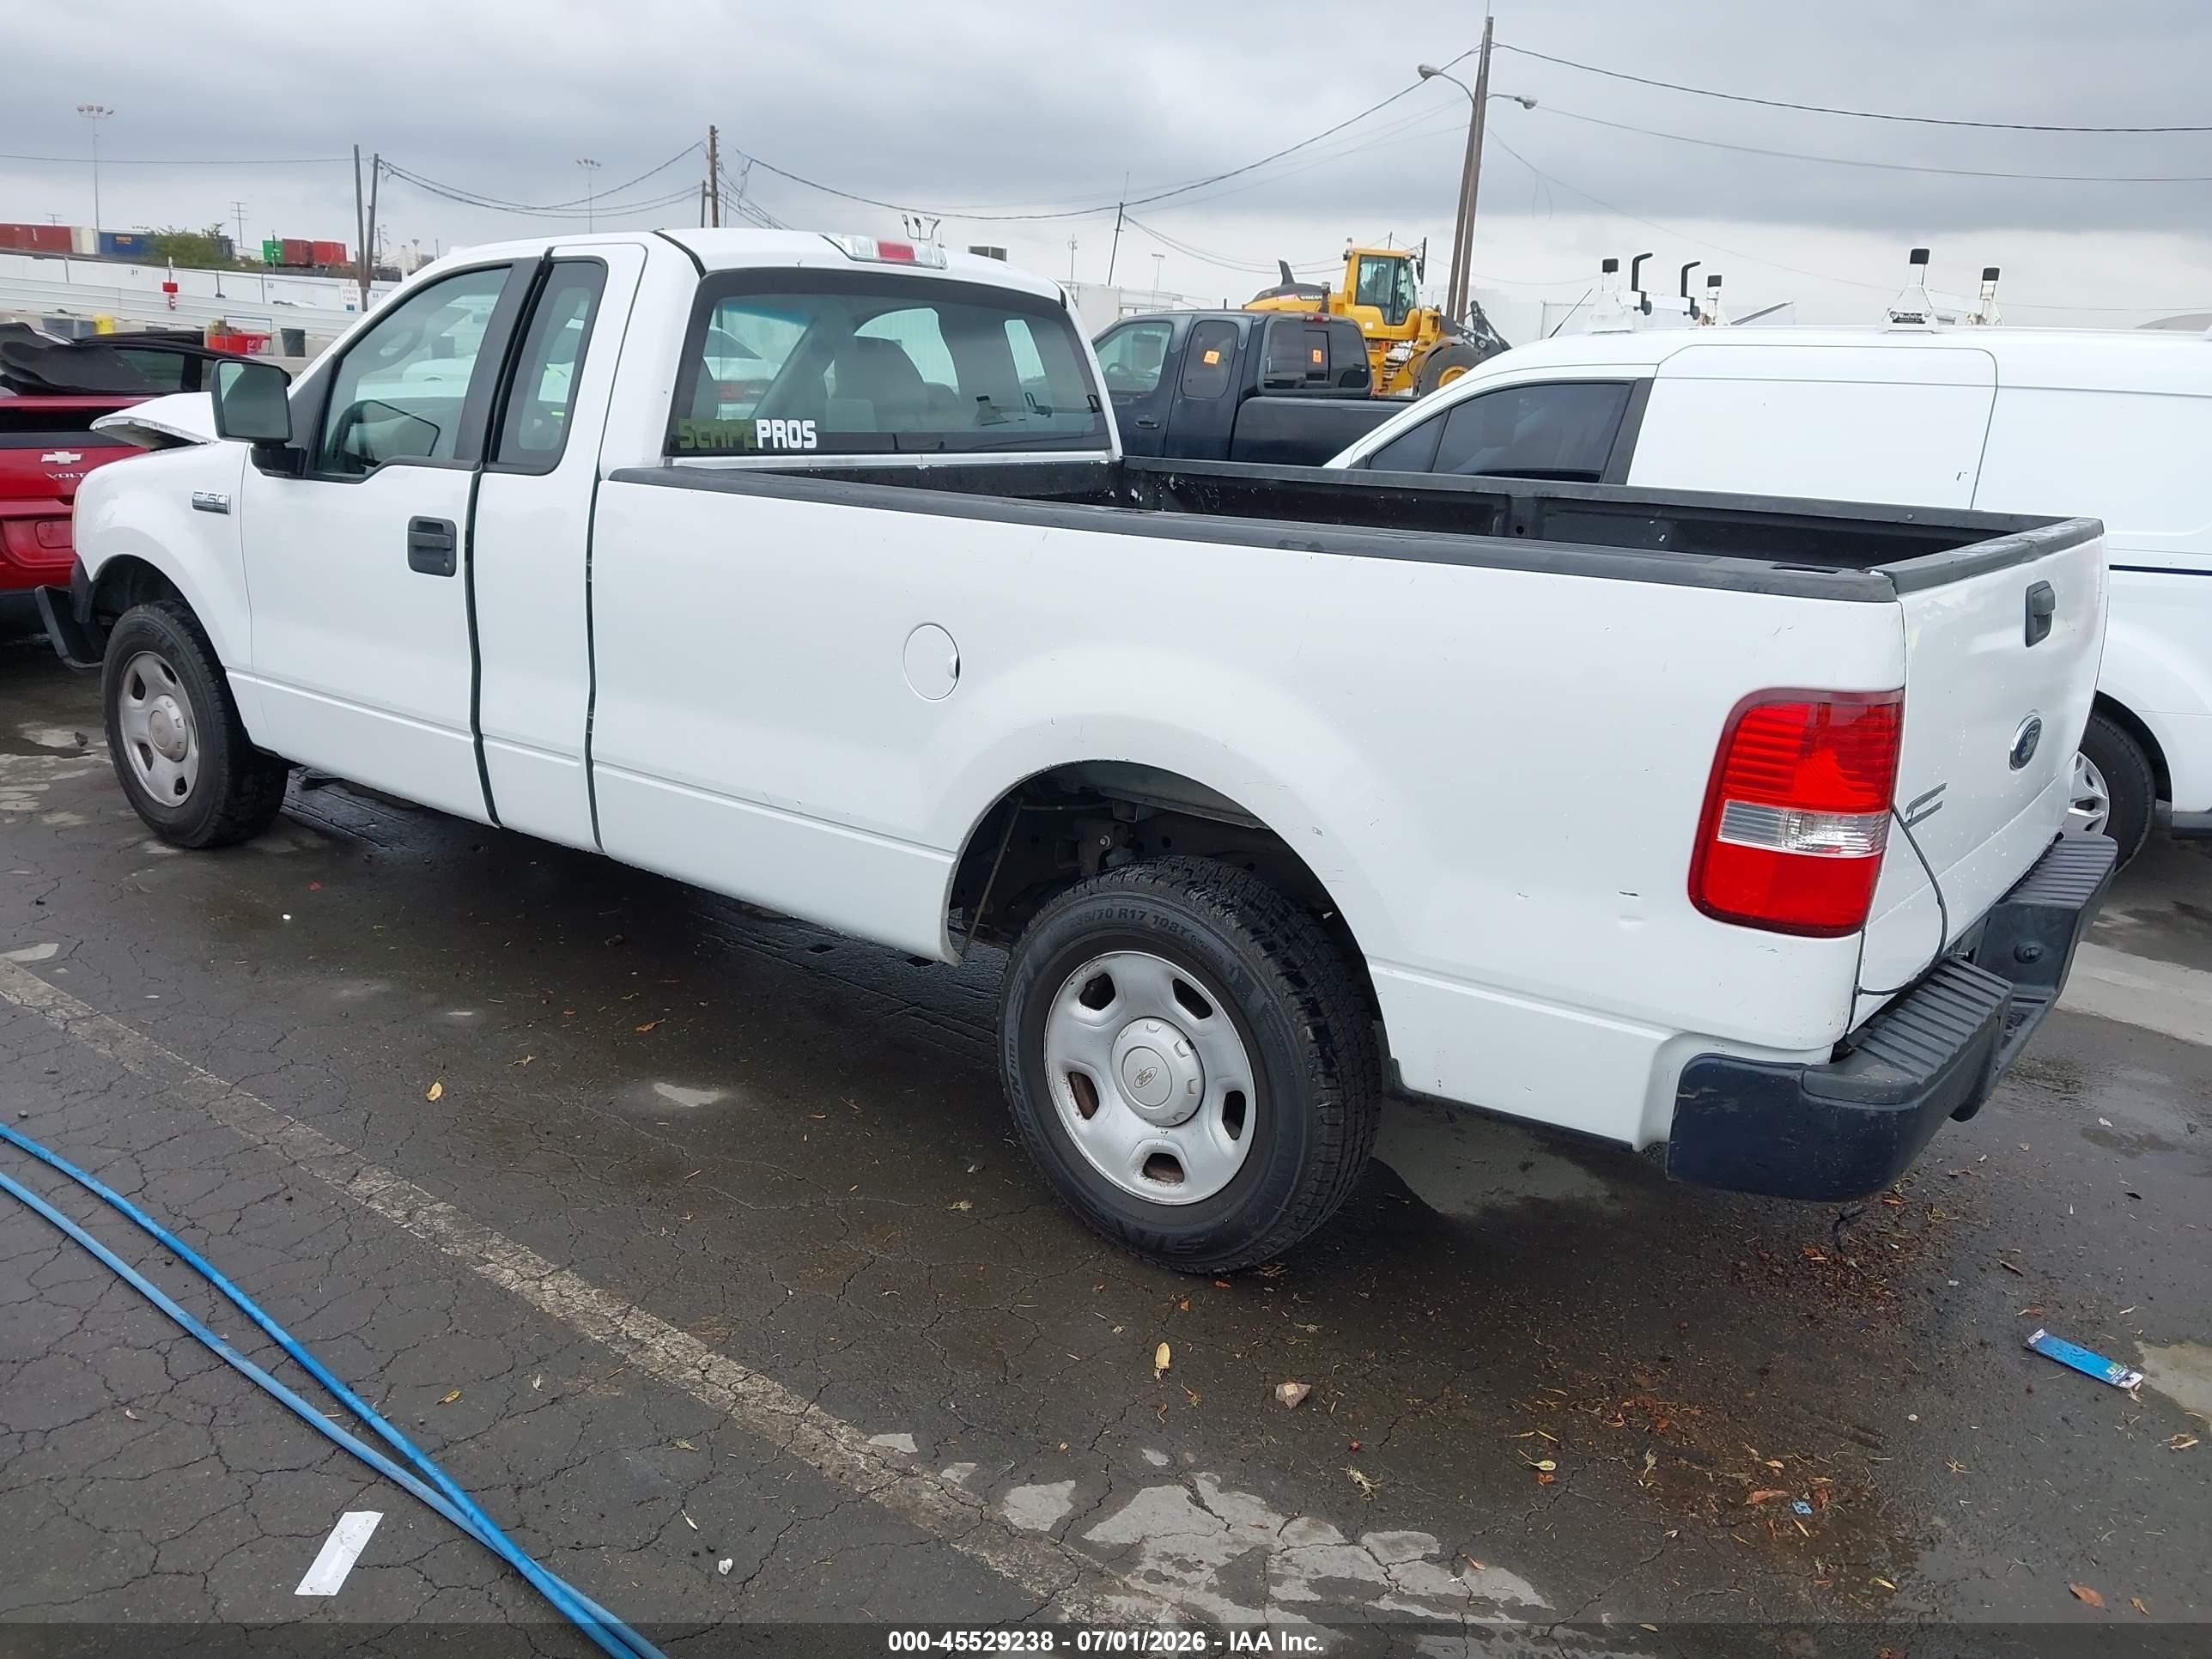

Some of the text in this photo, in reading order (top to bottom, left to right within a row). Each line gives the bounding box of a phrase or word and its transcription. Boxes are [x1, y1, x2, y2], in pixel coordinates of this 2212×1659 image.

[44, 471, 86, 481] VOLT
[1117, 908, 1148, 921] R17
[1138, 1069, 1153, 1085] Ford
